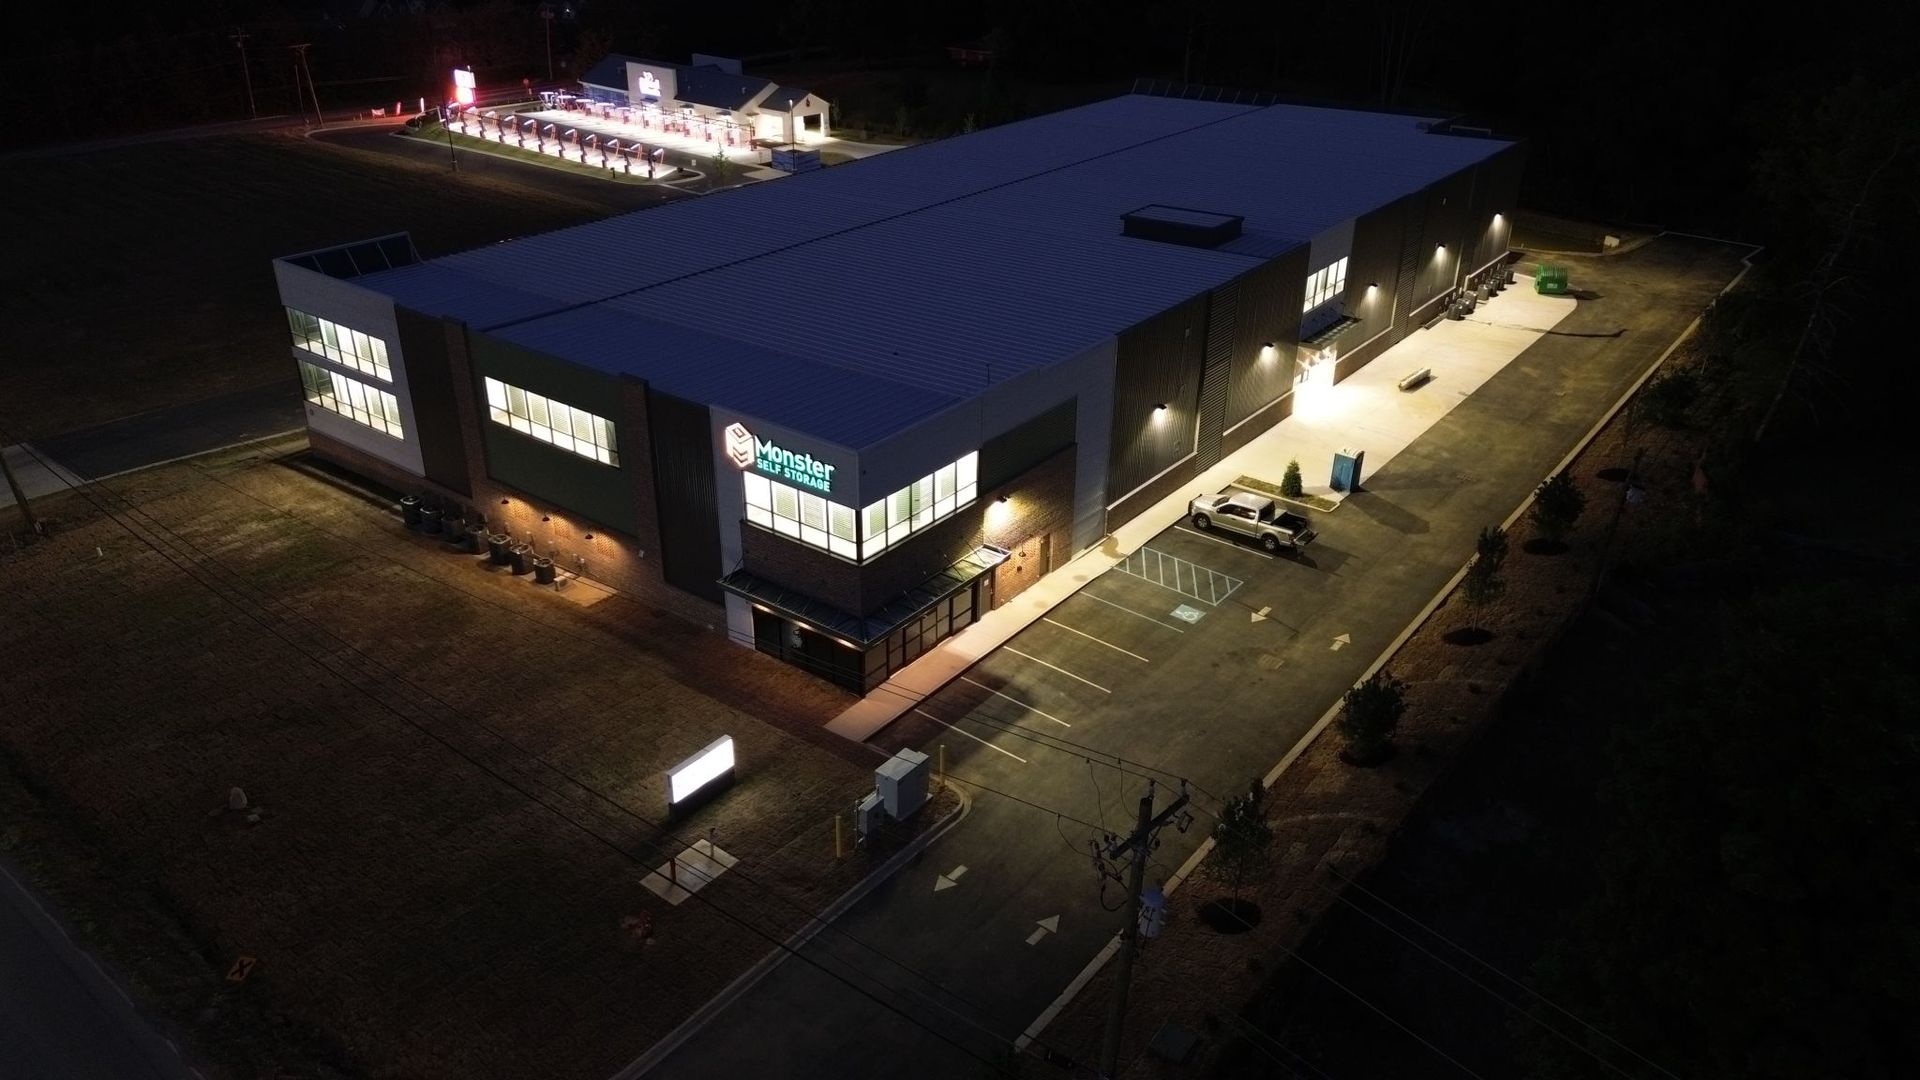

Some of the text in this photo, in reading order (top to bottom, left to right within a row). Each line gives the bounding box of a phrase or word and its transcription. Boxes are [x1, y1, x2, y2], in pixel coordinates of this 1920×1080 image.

[755, 435, 835, 480] Monster
[757, 458, 831, 492] SELF STORAGE
